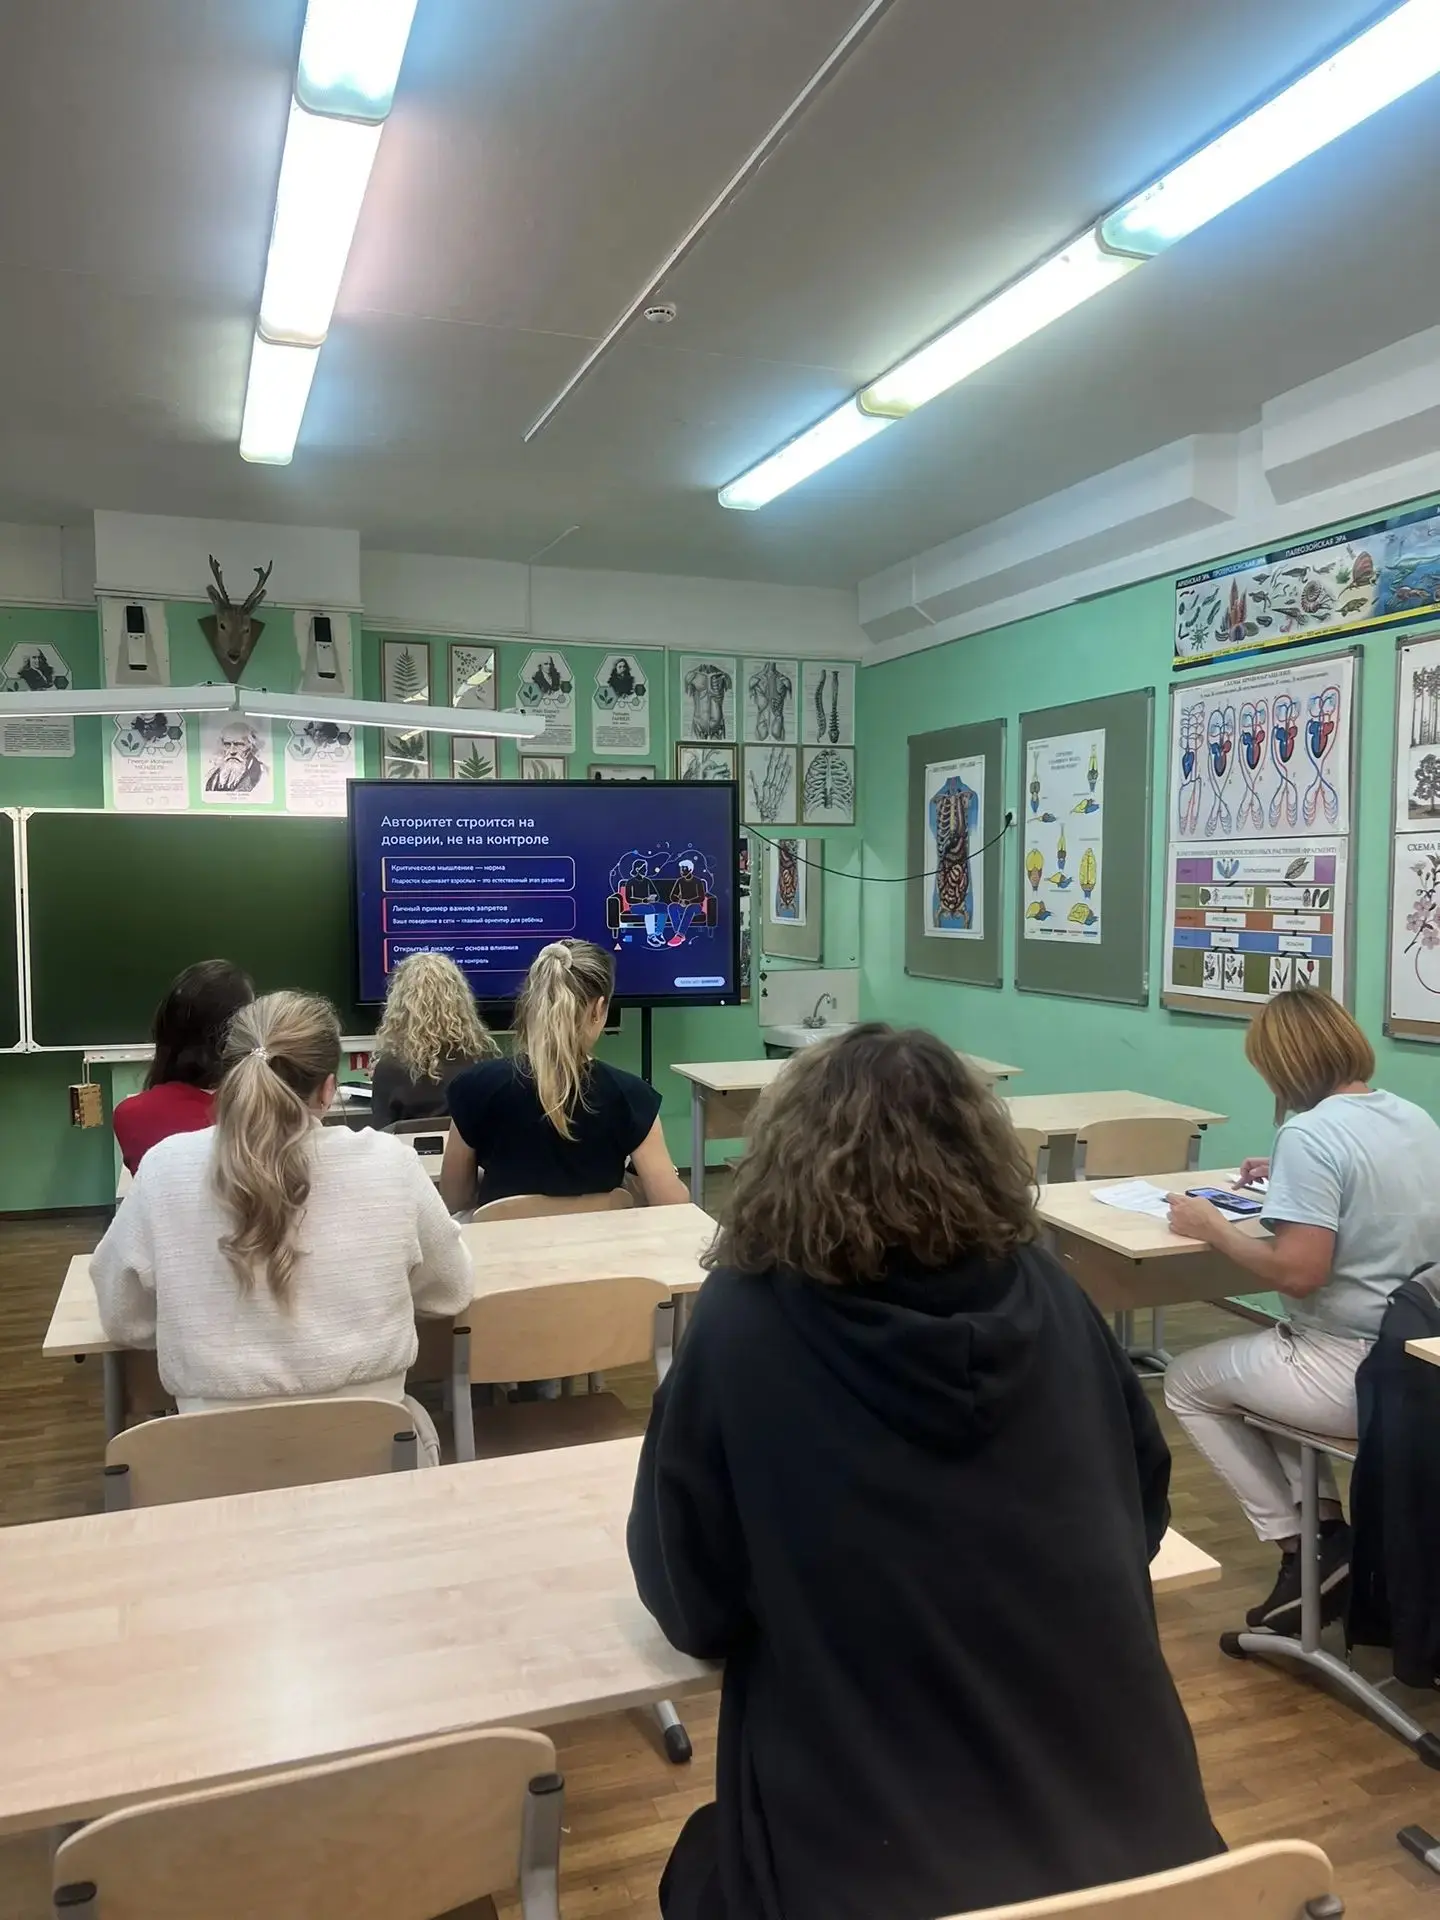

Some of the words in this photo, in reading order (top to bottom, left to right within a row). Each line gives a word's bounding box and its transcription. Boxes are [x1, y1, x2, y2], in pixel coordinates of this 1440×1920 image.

[1285, 539, 1334, 558] ПАЛЕОЗОЙСКАЯ
[1334, 534, 1347, 544] ЭРА
[380, 815, 453, 830] Авторитет
[456, 817, 515, 829] строится
[518, 818, 535, 828] на
[381, 835, 444, 847] доверии,
[447, 835, 463, 845] не
[467, 835, 483, 845] на
[486, 835, 550, 847] контроле
[1407, 842, 1436, 852] СХЕМА
[391, 864, 436, 872] Критическое
[421, 905, 448, 913] пример
[393, 945, 429, 953] Открытый
[430, 945, 455, 953] диалог
